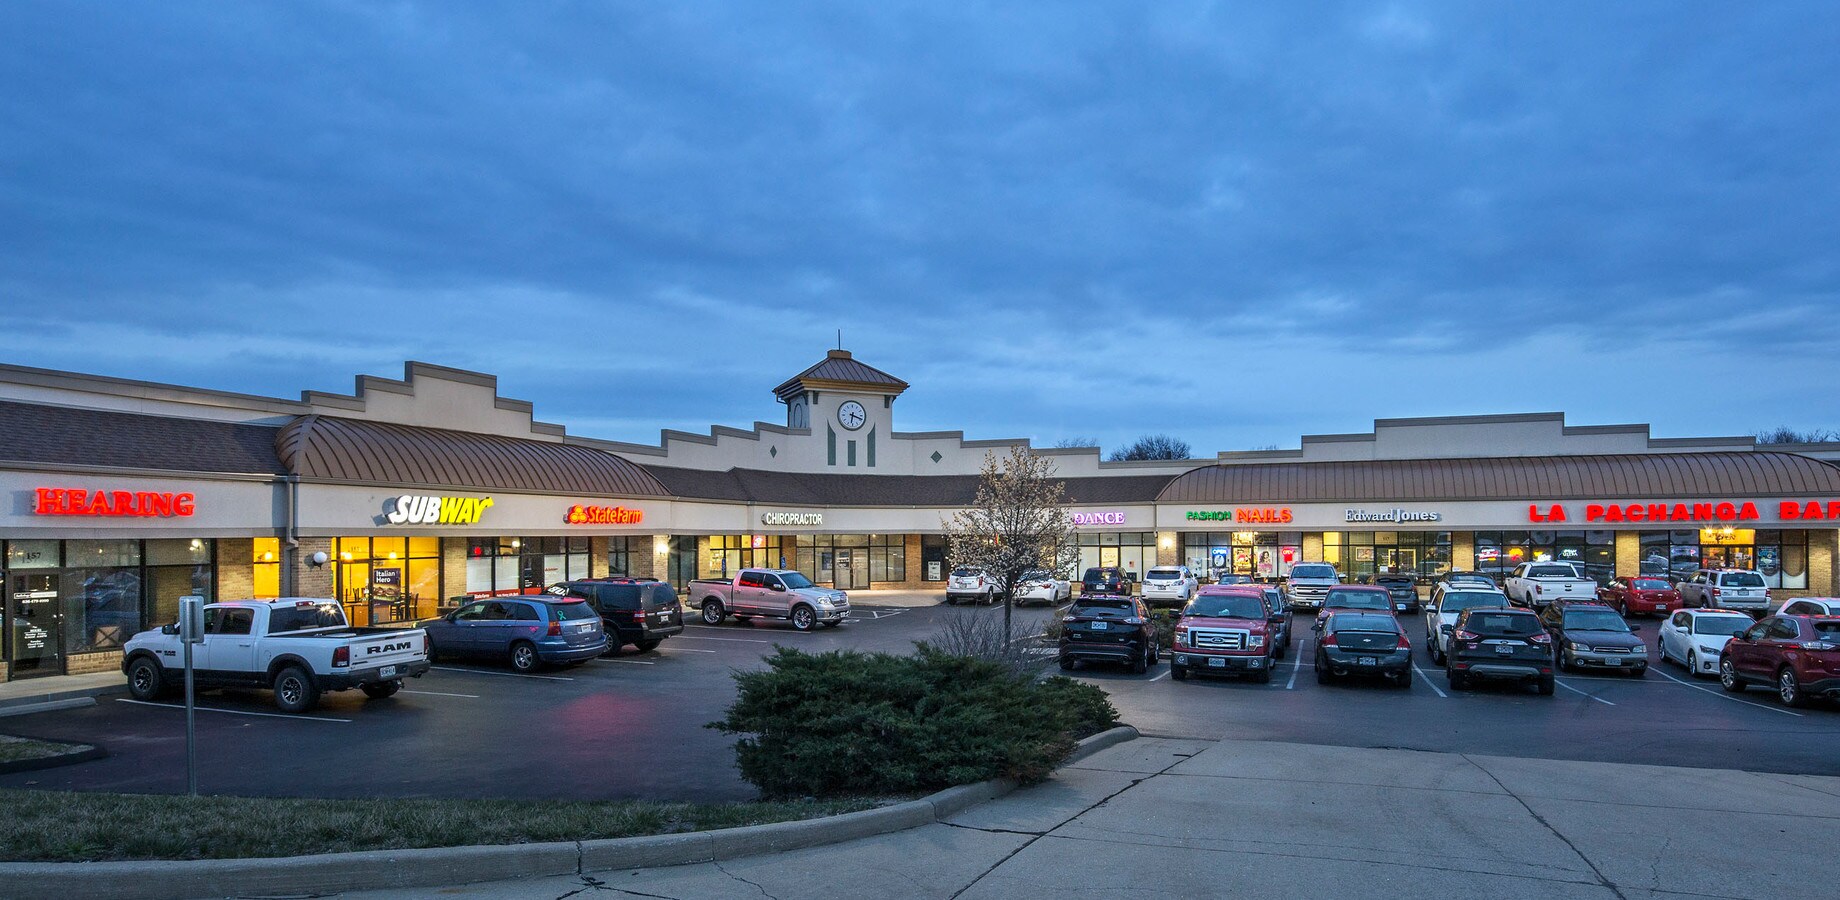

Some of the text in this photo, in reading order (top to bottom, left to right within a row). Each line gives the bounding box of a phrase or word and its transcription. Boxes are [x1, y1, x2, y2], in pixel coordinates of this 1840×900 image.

[35, 488, 195, 517] HEARING
[387, 495, 494, 524] SUBWAY
[766, 512, 823, 525] CHIROPRACTOR
[1074, 512, 1125, 525] DANCE
[1186, 507, 1293, 523] FASHION NAILS
[1345, 509, 1438, 523] Edward Jones
[1529, 504, 1566, 522] LA
[1586, 501, 1760, 522] PACHANGA
[367, 641, 411, 654] RAM
